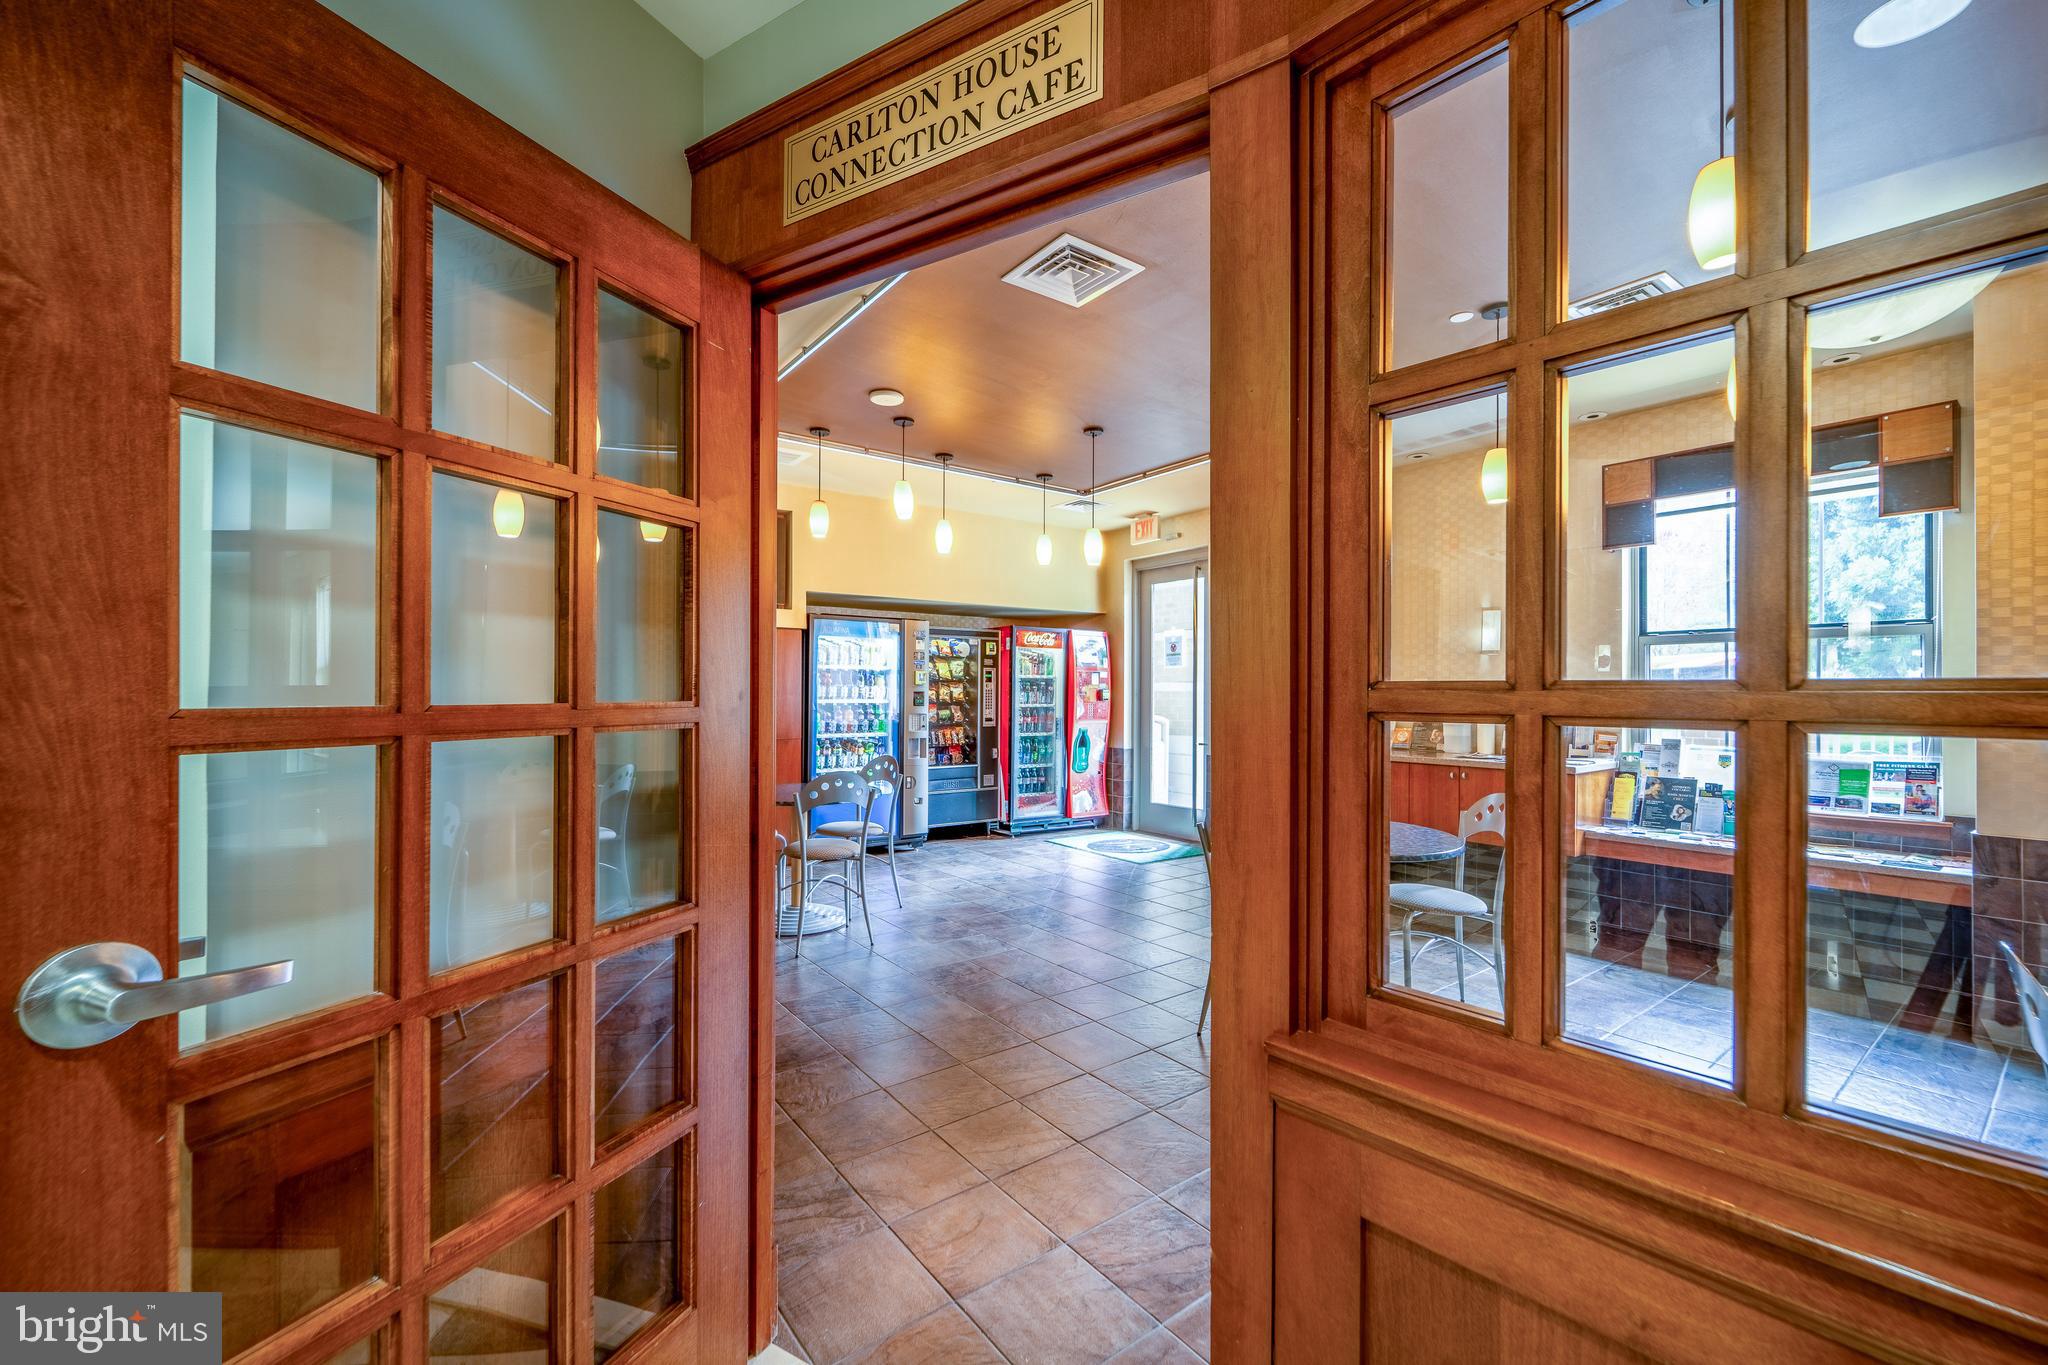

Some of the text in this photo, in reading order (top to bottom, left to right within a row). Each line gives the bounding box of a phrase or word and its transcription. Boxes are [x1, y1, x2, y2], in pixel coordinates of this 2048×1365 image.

[795, 58, 1086, 206] CONNECTION CAFE
[811, 25, 1062, 163] CARLTON HOUSE
[1135, 518, 1153, 541] EXIT
